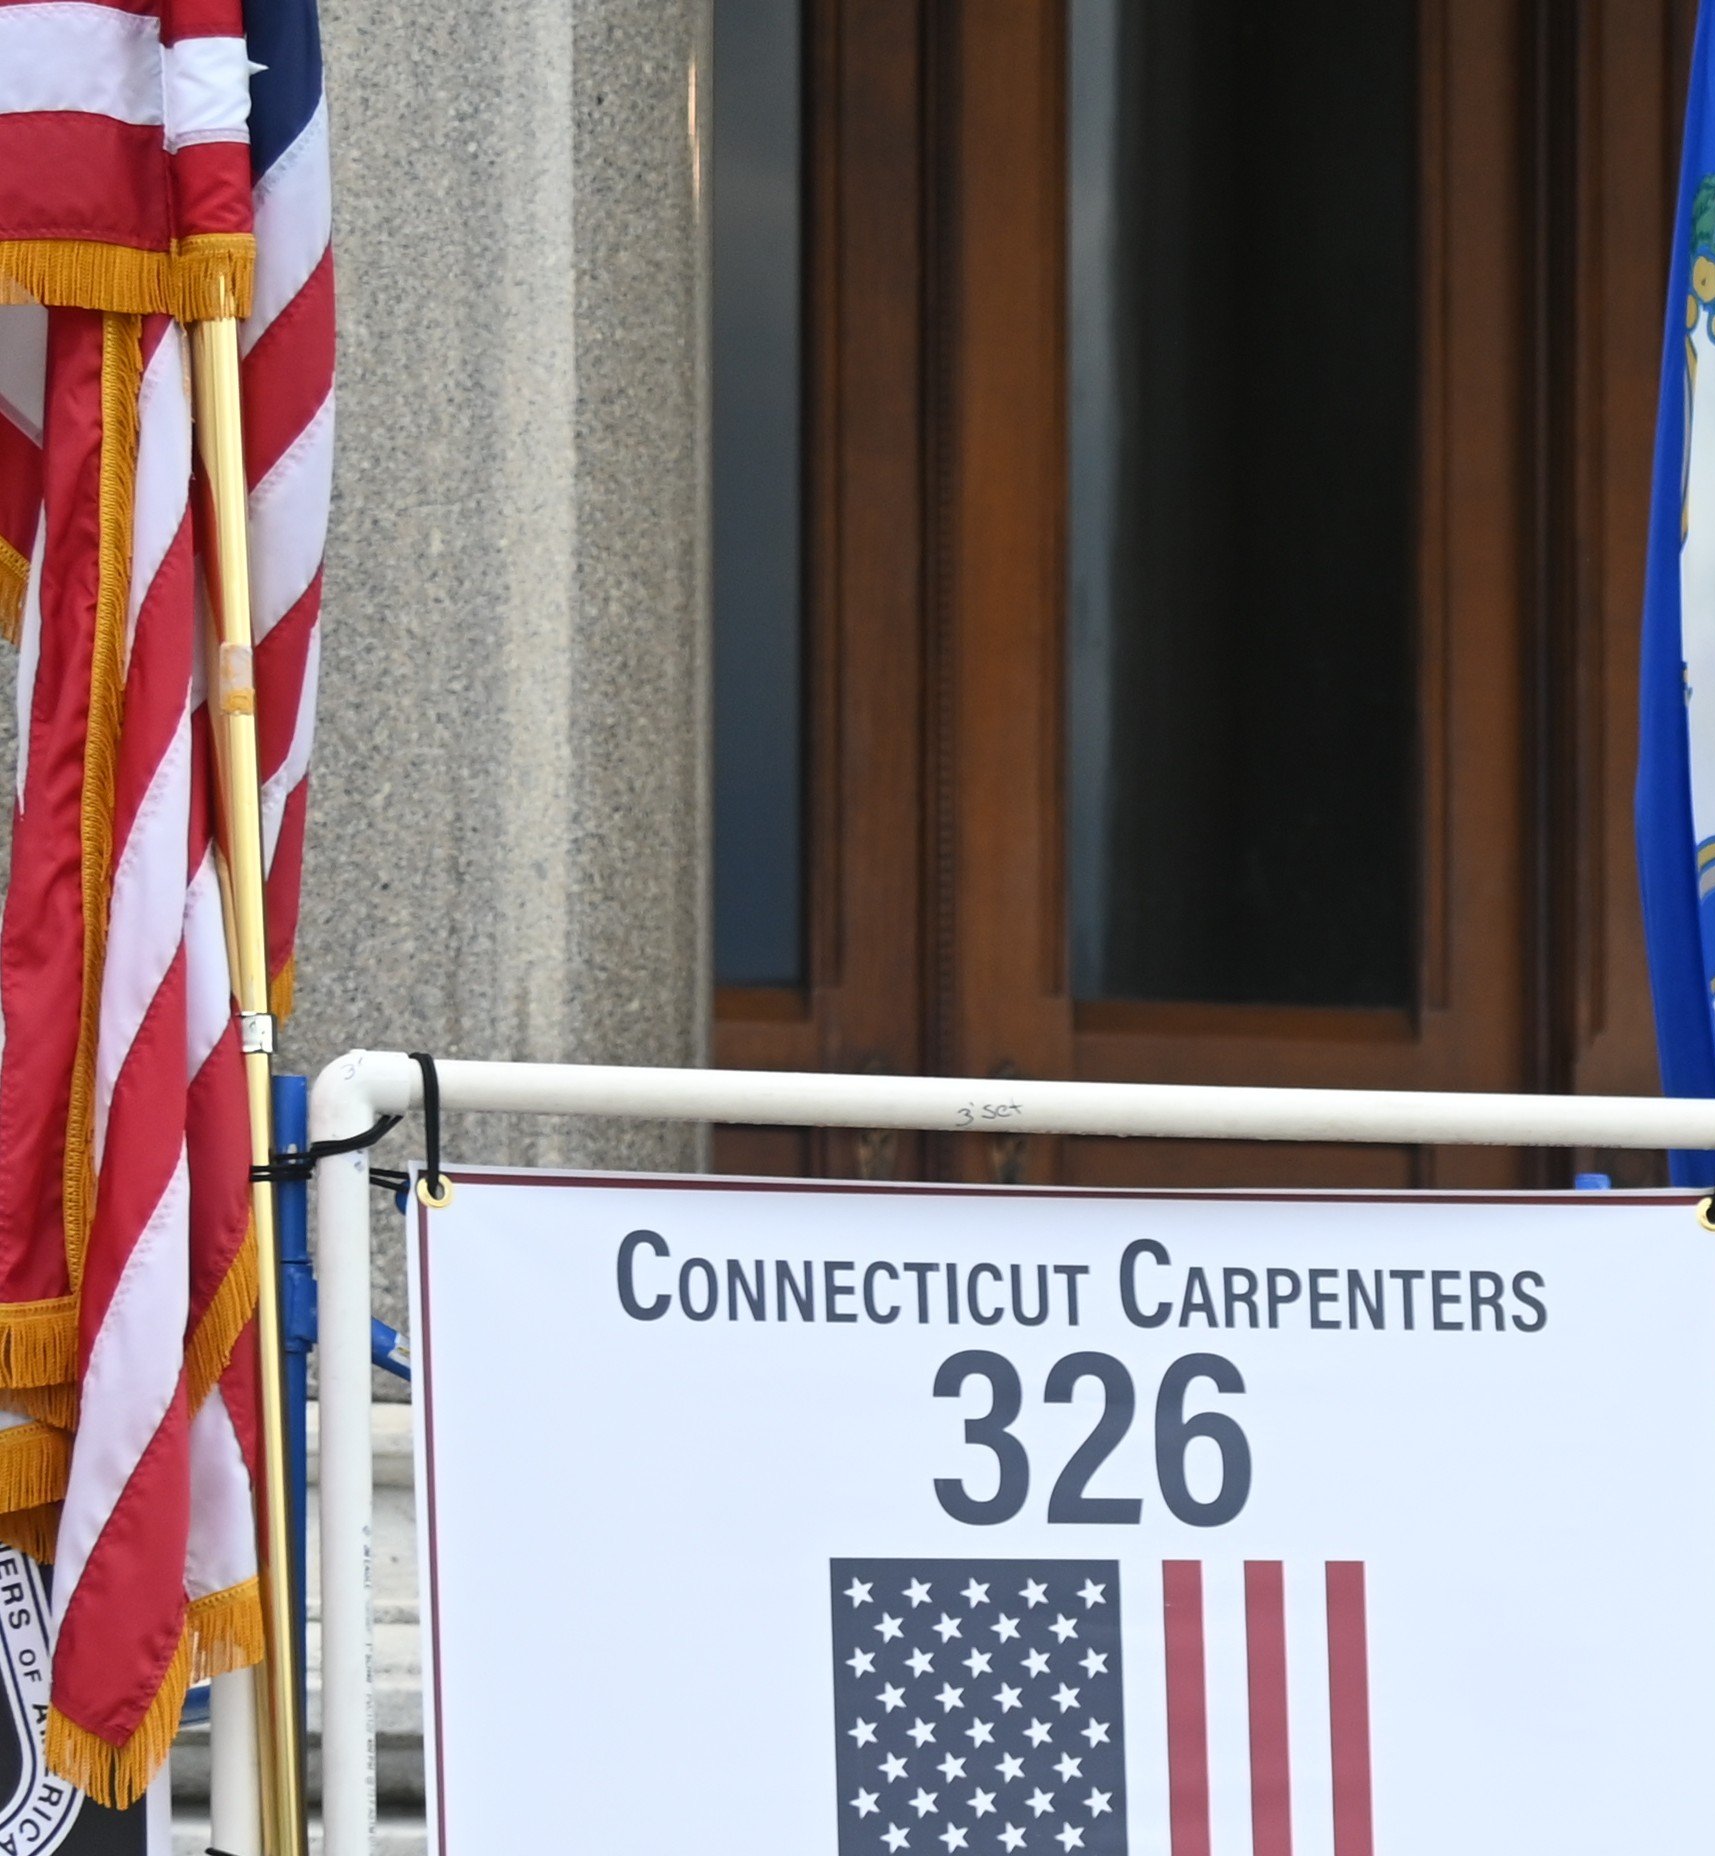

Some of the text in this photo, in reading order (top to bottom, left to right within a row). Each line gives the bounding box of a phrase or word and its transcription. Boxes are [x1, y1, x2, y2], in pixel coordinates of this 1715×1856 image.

[616, 1229, 1549, 1333] CONNECTICUT CARPENTERS
[932, 1349, 1253, 1528] 326
[18, 1648, 43, 1683] OF
